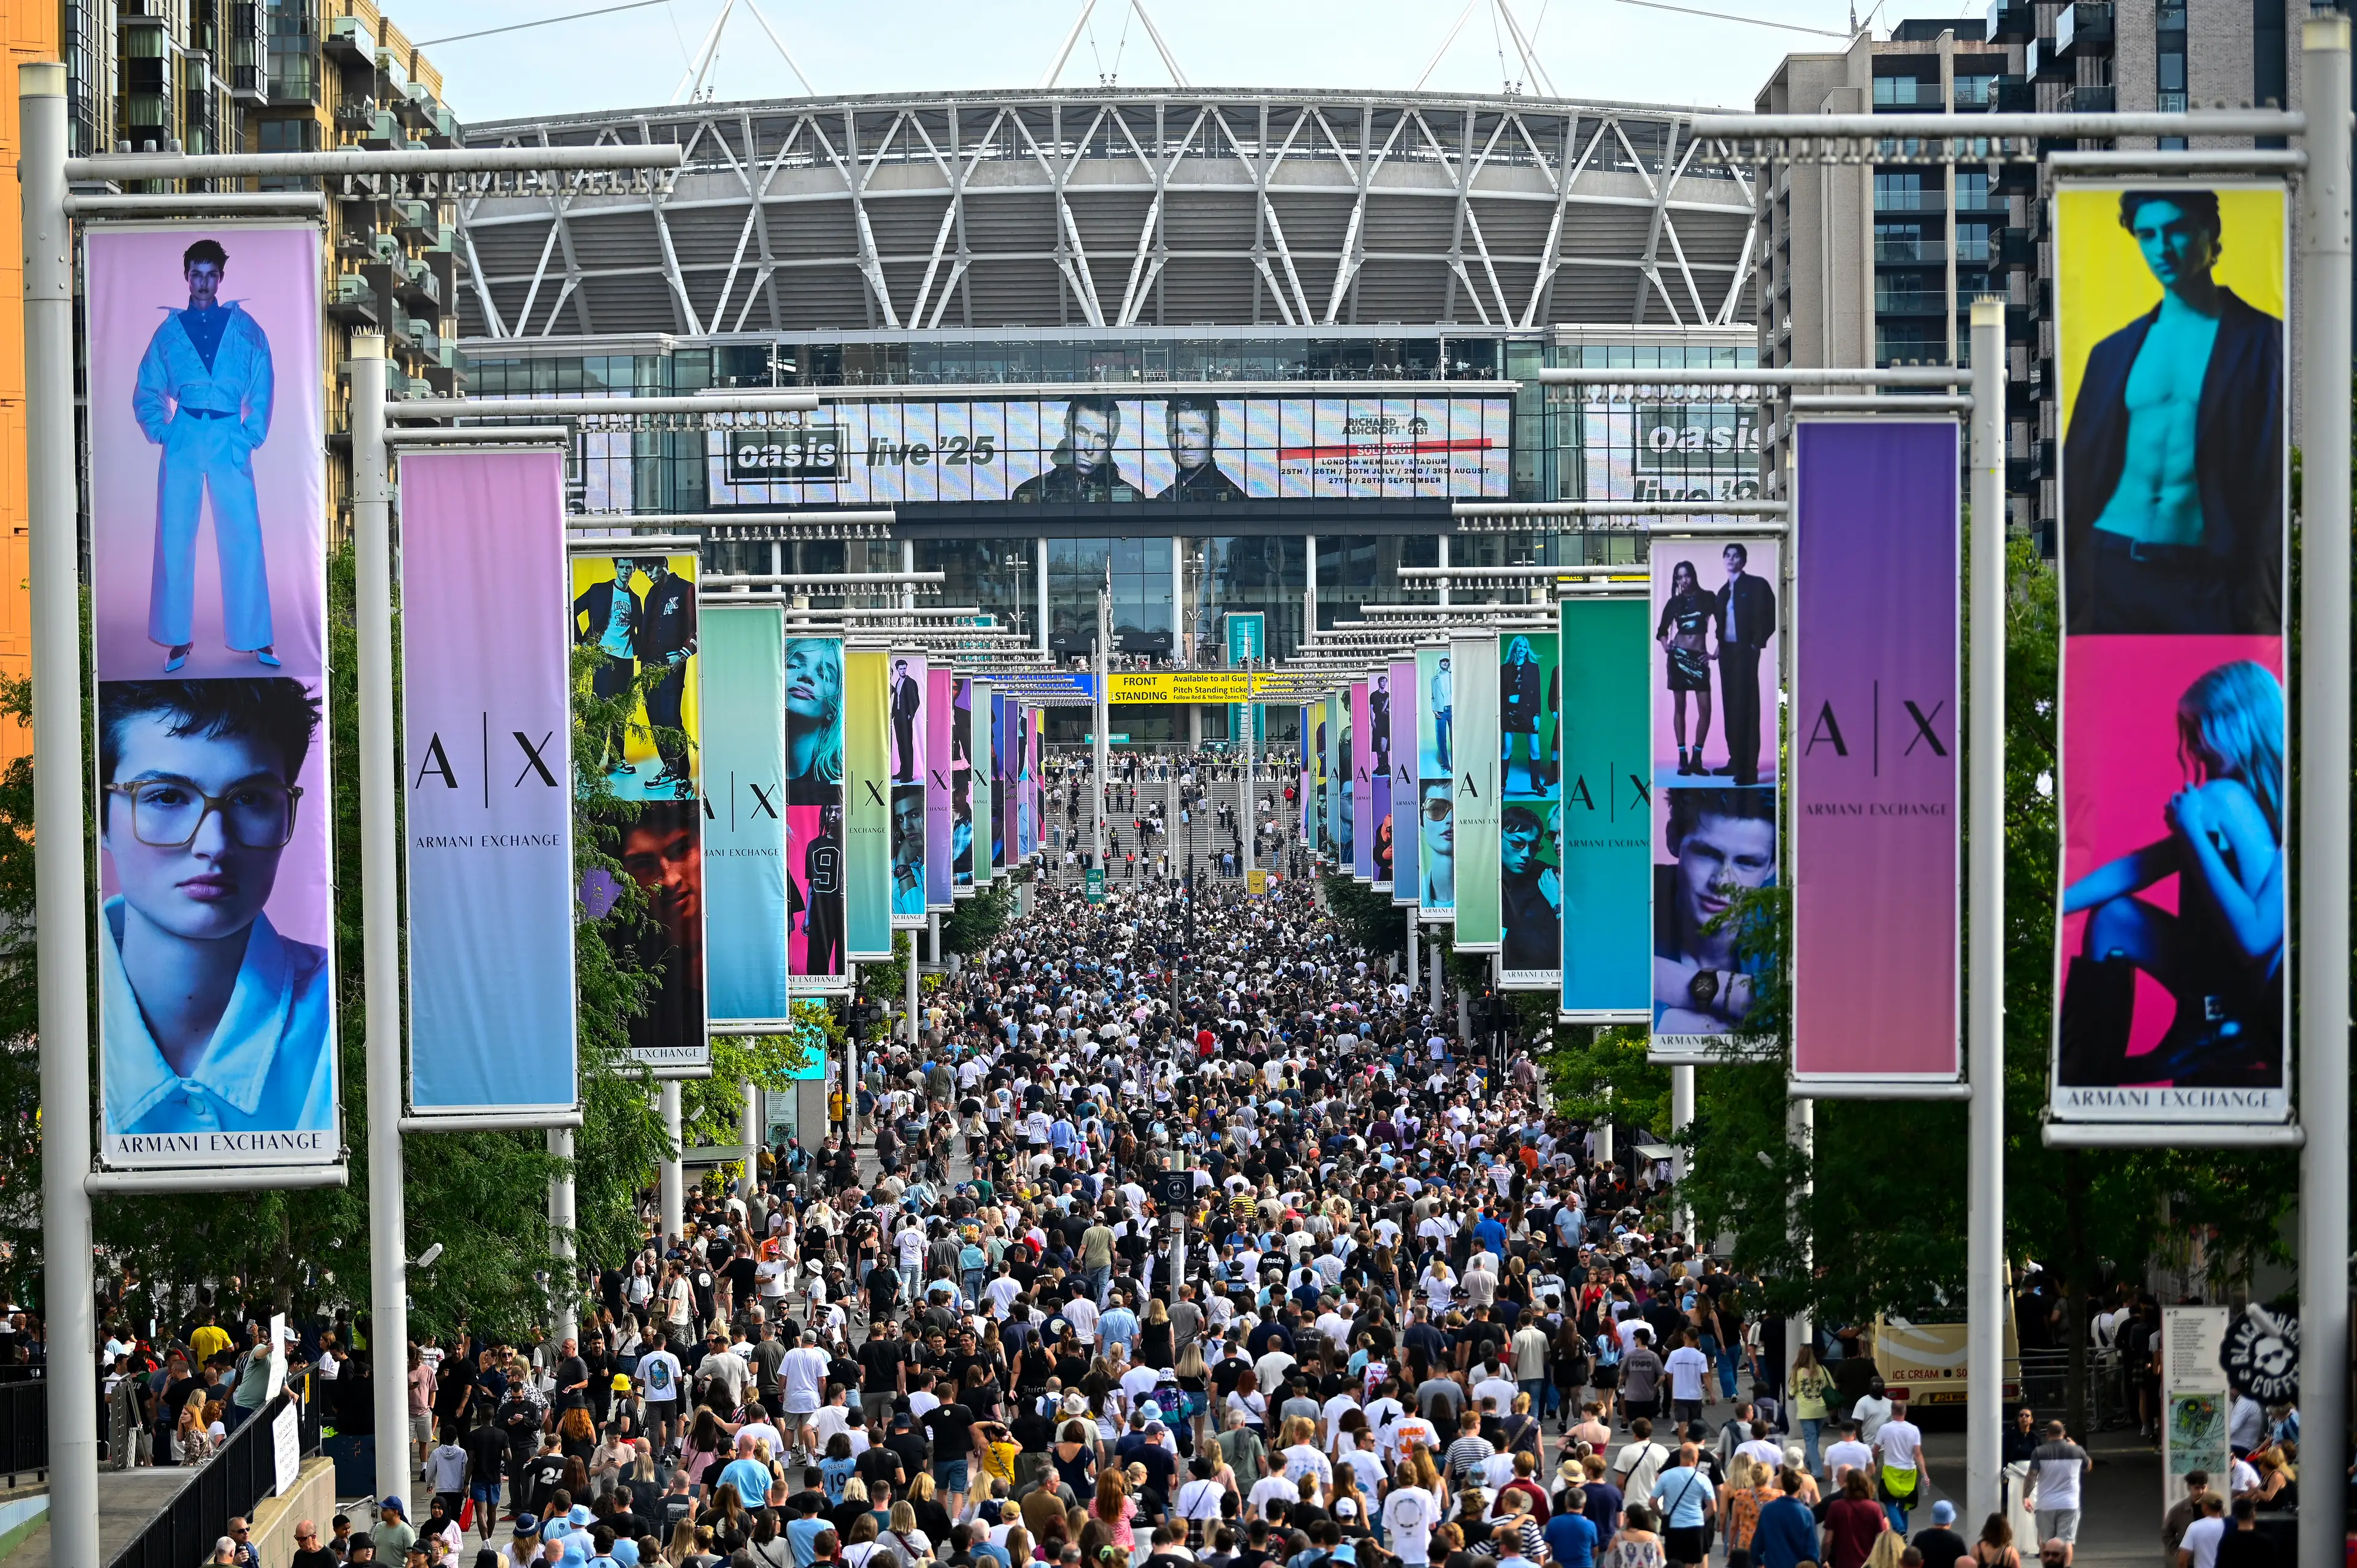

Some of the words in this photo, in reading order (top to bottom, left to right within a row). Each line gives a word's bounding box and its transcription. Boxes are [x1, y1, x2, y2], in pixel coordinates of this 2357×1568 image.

[1346, 418, 1396, 427] RICHARD
[1342, 426, 1399, 434] ASHCROFT
[737, 436, 837, 469] oasis
[866, 436, 930, 466] live
[939, 436, 995, 465] '25
[1357, 444, 1387, 456] SOLD
[1390, 442, 1412, 454] OUT
[1123, 677, 1158, 686] FRONT
[1115, 692, 1167, 700] STANDING
[1194, 686, 1228, 695] Standing
[931, 769, 947, 790] X
[974, 769, 988, 786] X
[1329, 767, 1338, 781] A
[1355, 766, 1368, 783] A
[1395, 764, 1411, 785] A
[1805, 803, 1862, 816] ARMANI
[1869, 803, 1948, 816] EXCHANGE
[416, 835, 473, 849] ARMANI
[481, 834, 560, 848] EXCHANGE
[729, 848, 780, 857] EXCHANGE
[813, 846, 840, 893] 9
[1660, 1036, 1704, 1045] ARMANI
[638, 1048, 699, 1058] EXCHANGE
[2067, 1091, 2149, 1107] ARMANI
[2160, 1090, 2270, 1108] EXCHANGE
[117, 1135, 199, 1153] ARMANI
[211, 1132, 323, 1151] EXCHANGE
[1892, 1370, 1905, 1380] ICE
[1908, 1369, 1939, 1378] CREAM
